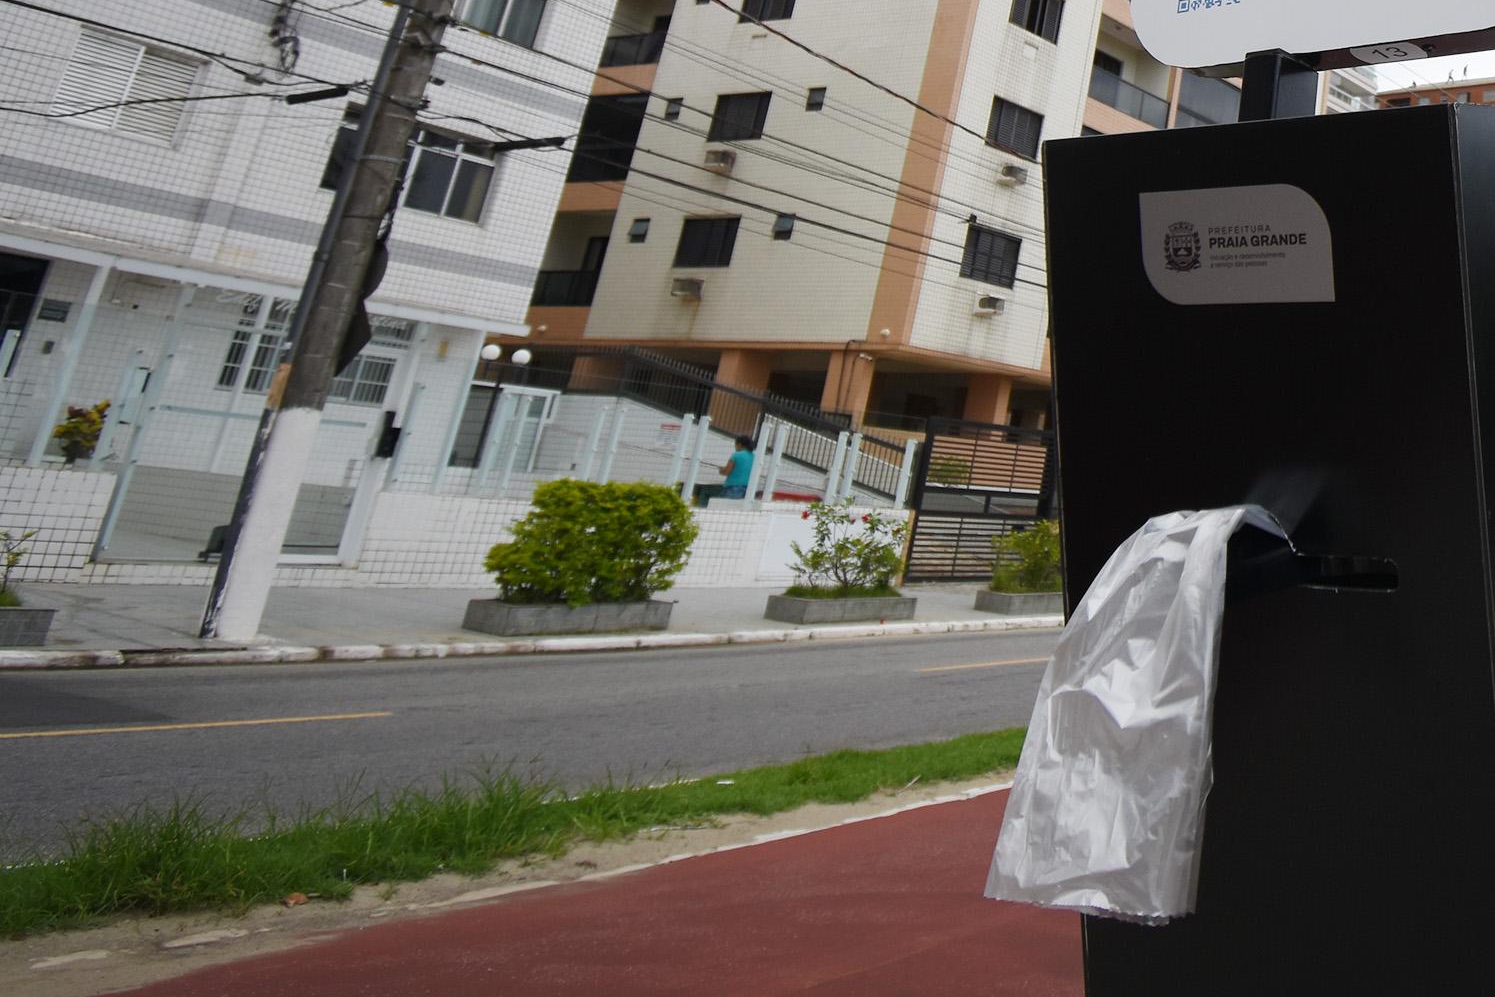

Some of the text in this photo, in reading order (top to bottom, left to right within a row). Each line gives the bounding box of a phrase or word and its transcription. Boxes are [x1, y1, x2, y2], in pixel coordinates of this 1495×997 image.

[1372, 47, 1408, 59] 13
[1208, 224, 1271, 235] PREFEITURA
[1209, 233, 1307, 249] PRAIA GRANDE
